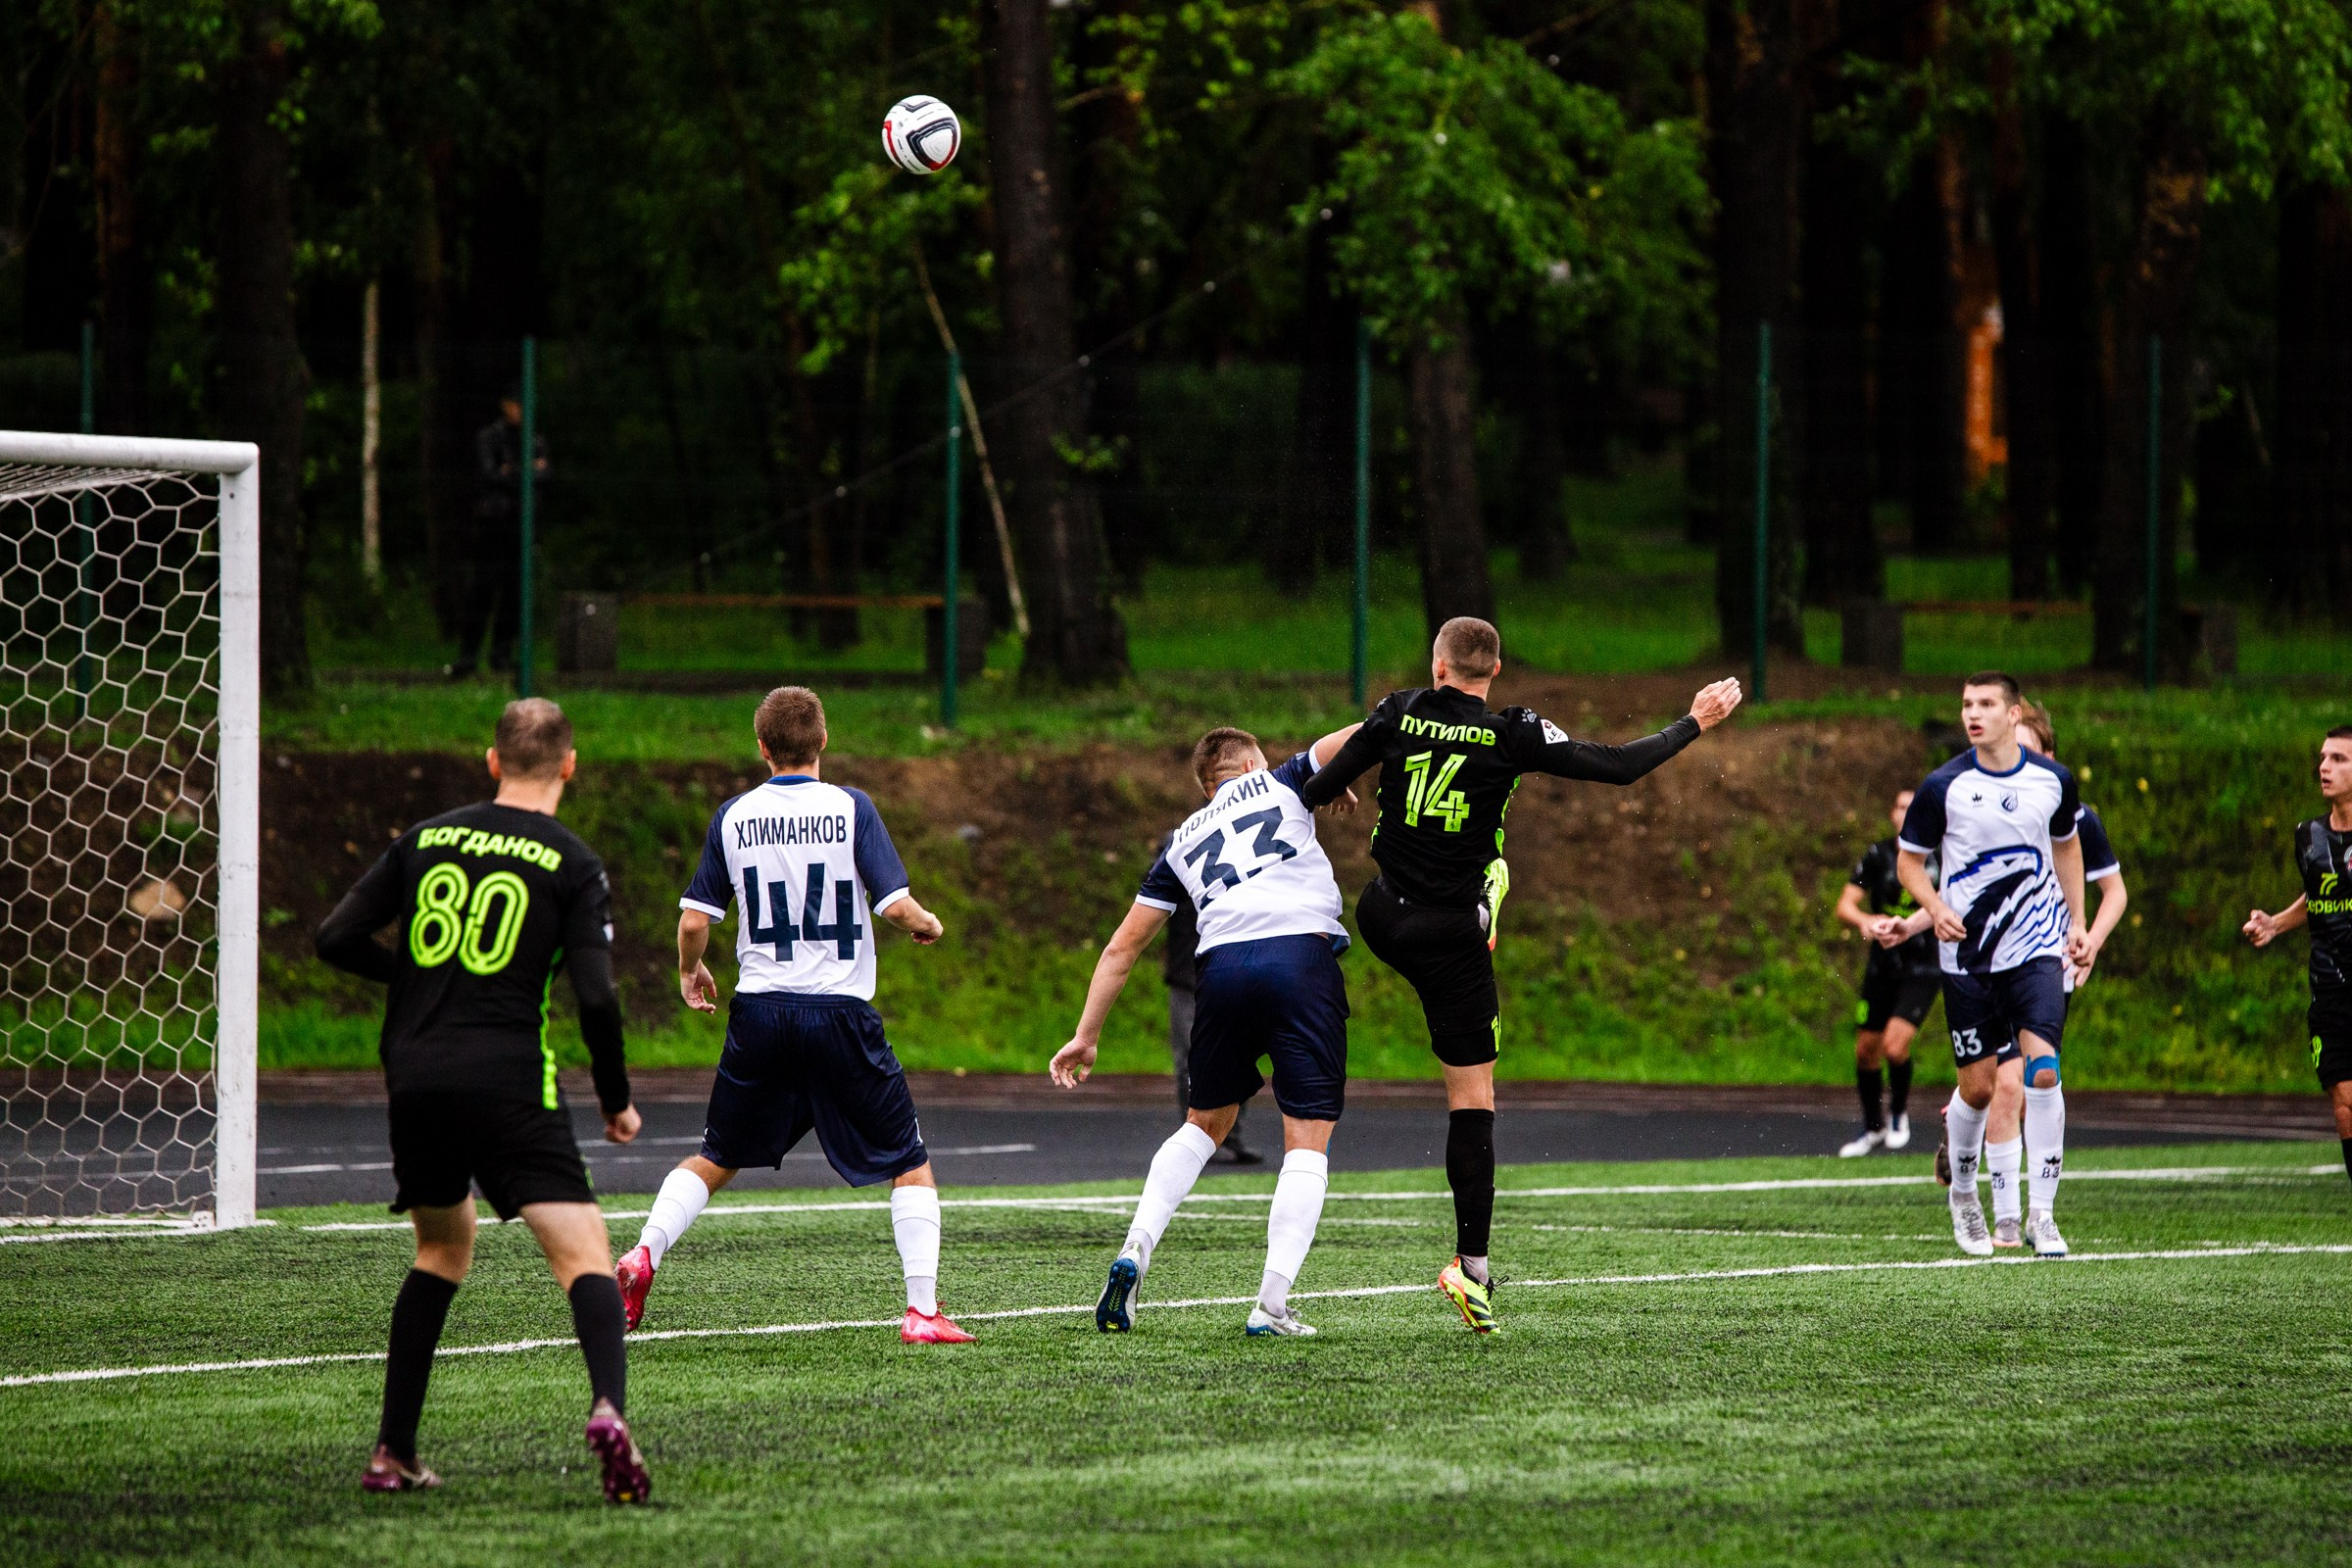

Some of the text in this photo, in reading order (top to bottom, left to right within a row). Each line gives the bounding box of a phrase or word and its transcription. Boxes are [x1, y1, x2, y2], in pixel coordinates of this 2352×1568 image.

[1399, 713, 1496, 747] ПУТИЛОВ
[1403, 750, 1470, 832] 14
[416, 826, 563, 872] БОГДАНОВ
[734, 814, 847, 850] ХЛИМАНКОВ
[1183, 806, 1298, 910] 33
[409, 861, 530, 976] 80
[742, 861, 863, 962] 44
[2307, 898, 2352, 915] ервик
[1952, 1027, 1983, 1057] 83
